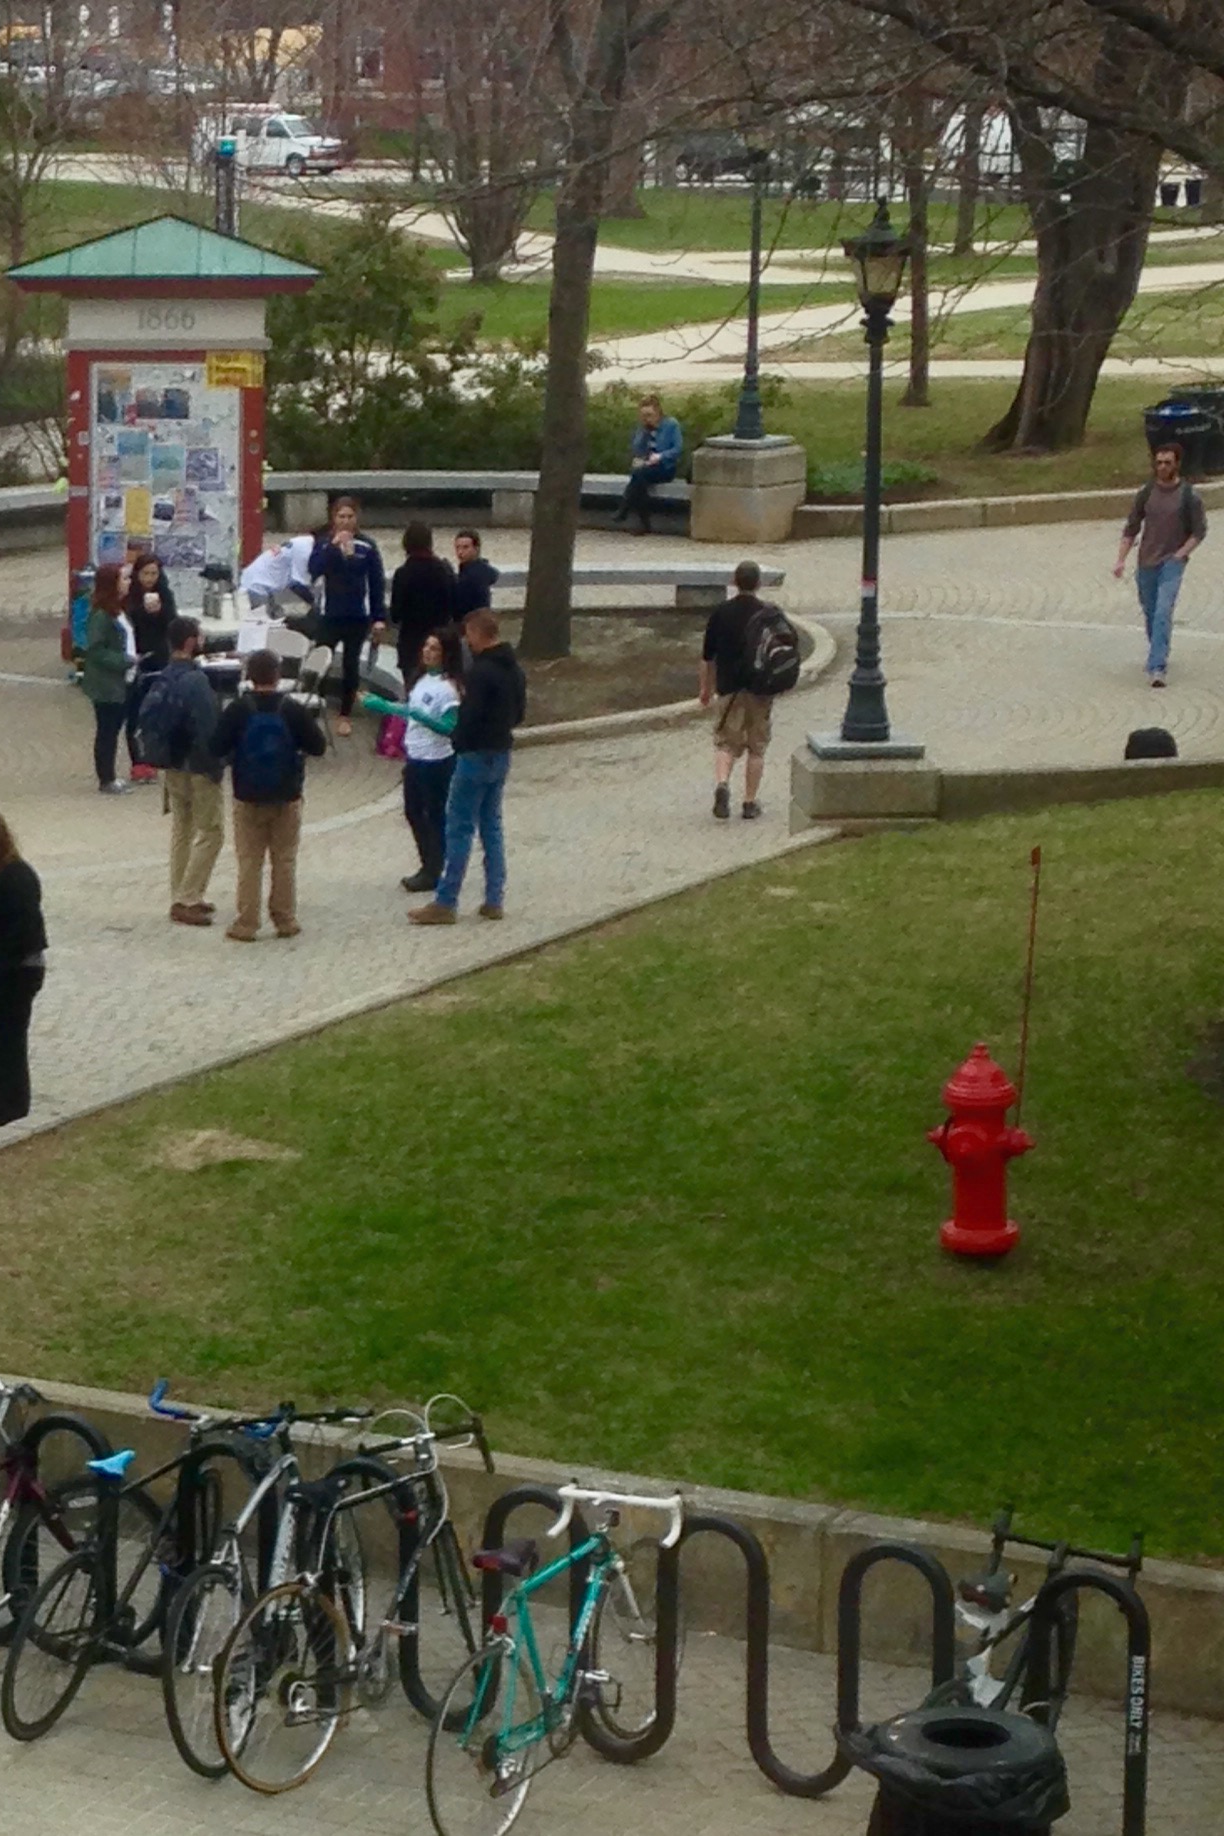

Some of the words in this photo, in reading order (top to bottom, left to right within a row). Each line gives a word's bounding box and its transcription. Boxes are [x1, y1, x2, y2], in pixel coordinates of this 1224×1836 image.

[138, 305, 195, 330] 1866
[1132, 1655, 1145, 1695] BIKES
[1130, 1697, 1144, 1728] ONLY
